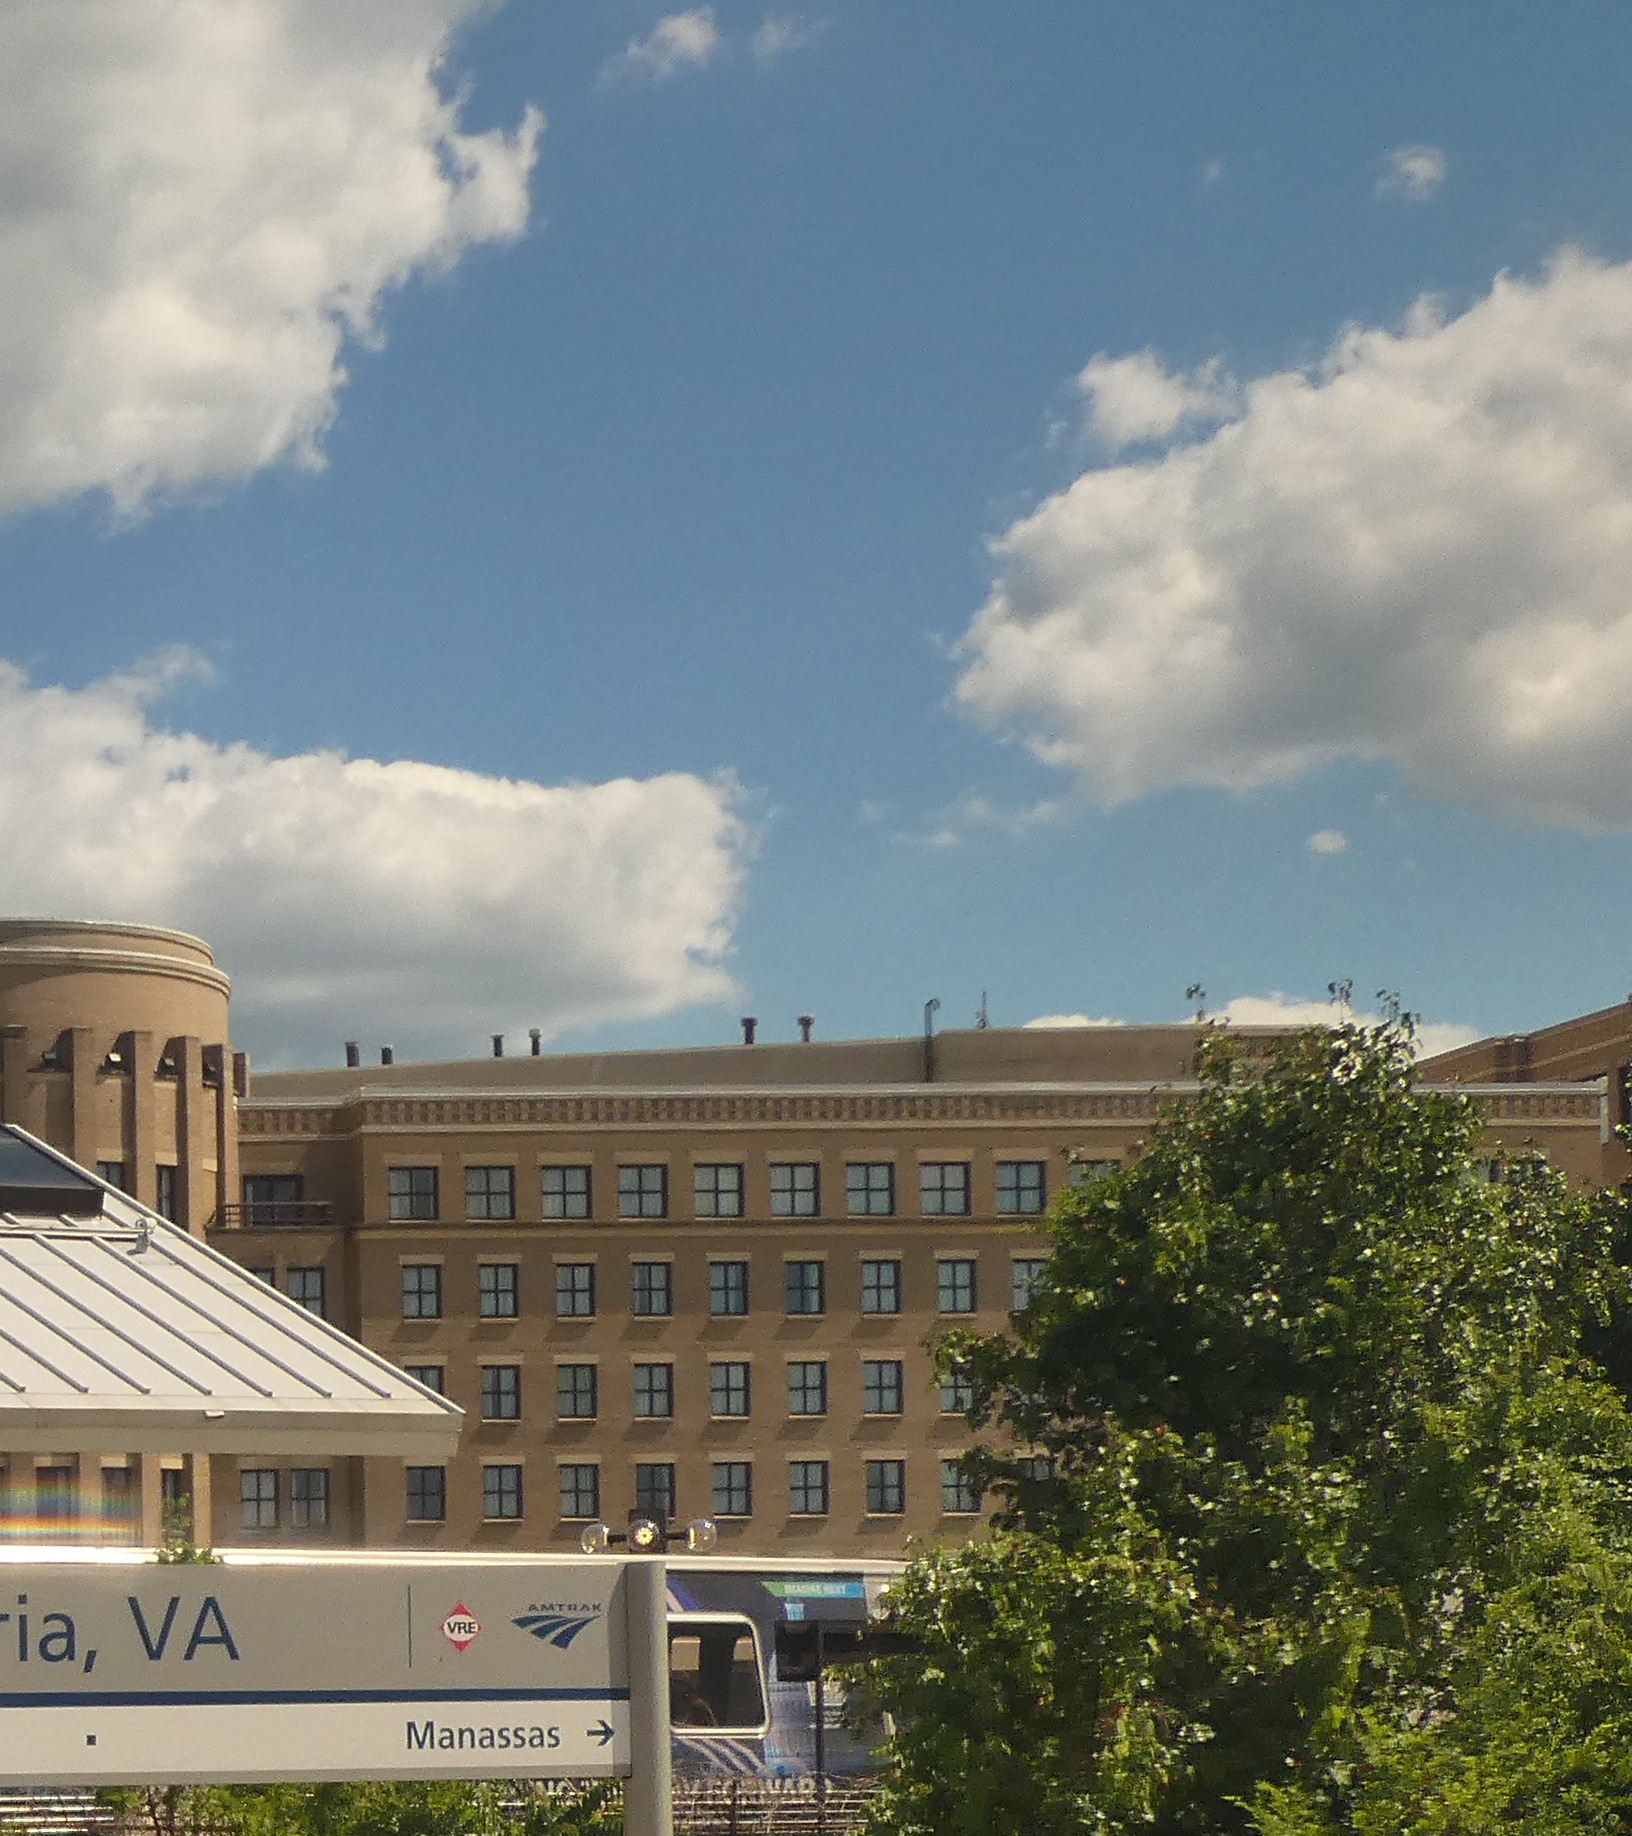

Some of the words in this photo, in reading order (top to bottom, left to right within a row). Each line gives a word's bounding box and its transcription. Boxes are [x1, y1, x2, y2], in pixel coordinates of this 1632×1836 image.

[528, 1603, 603, 1612] AMTRAK
[126, 1596, 241, 1663] VA
[447, 1621, 477, 1635] VRE
[405, 1720, 562, 1750] Manassas
